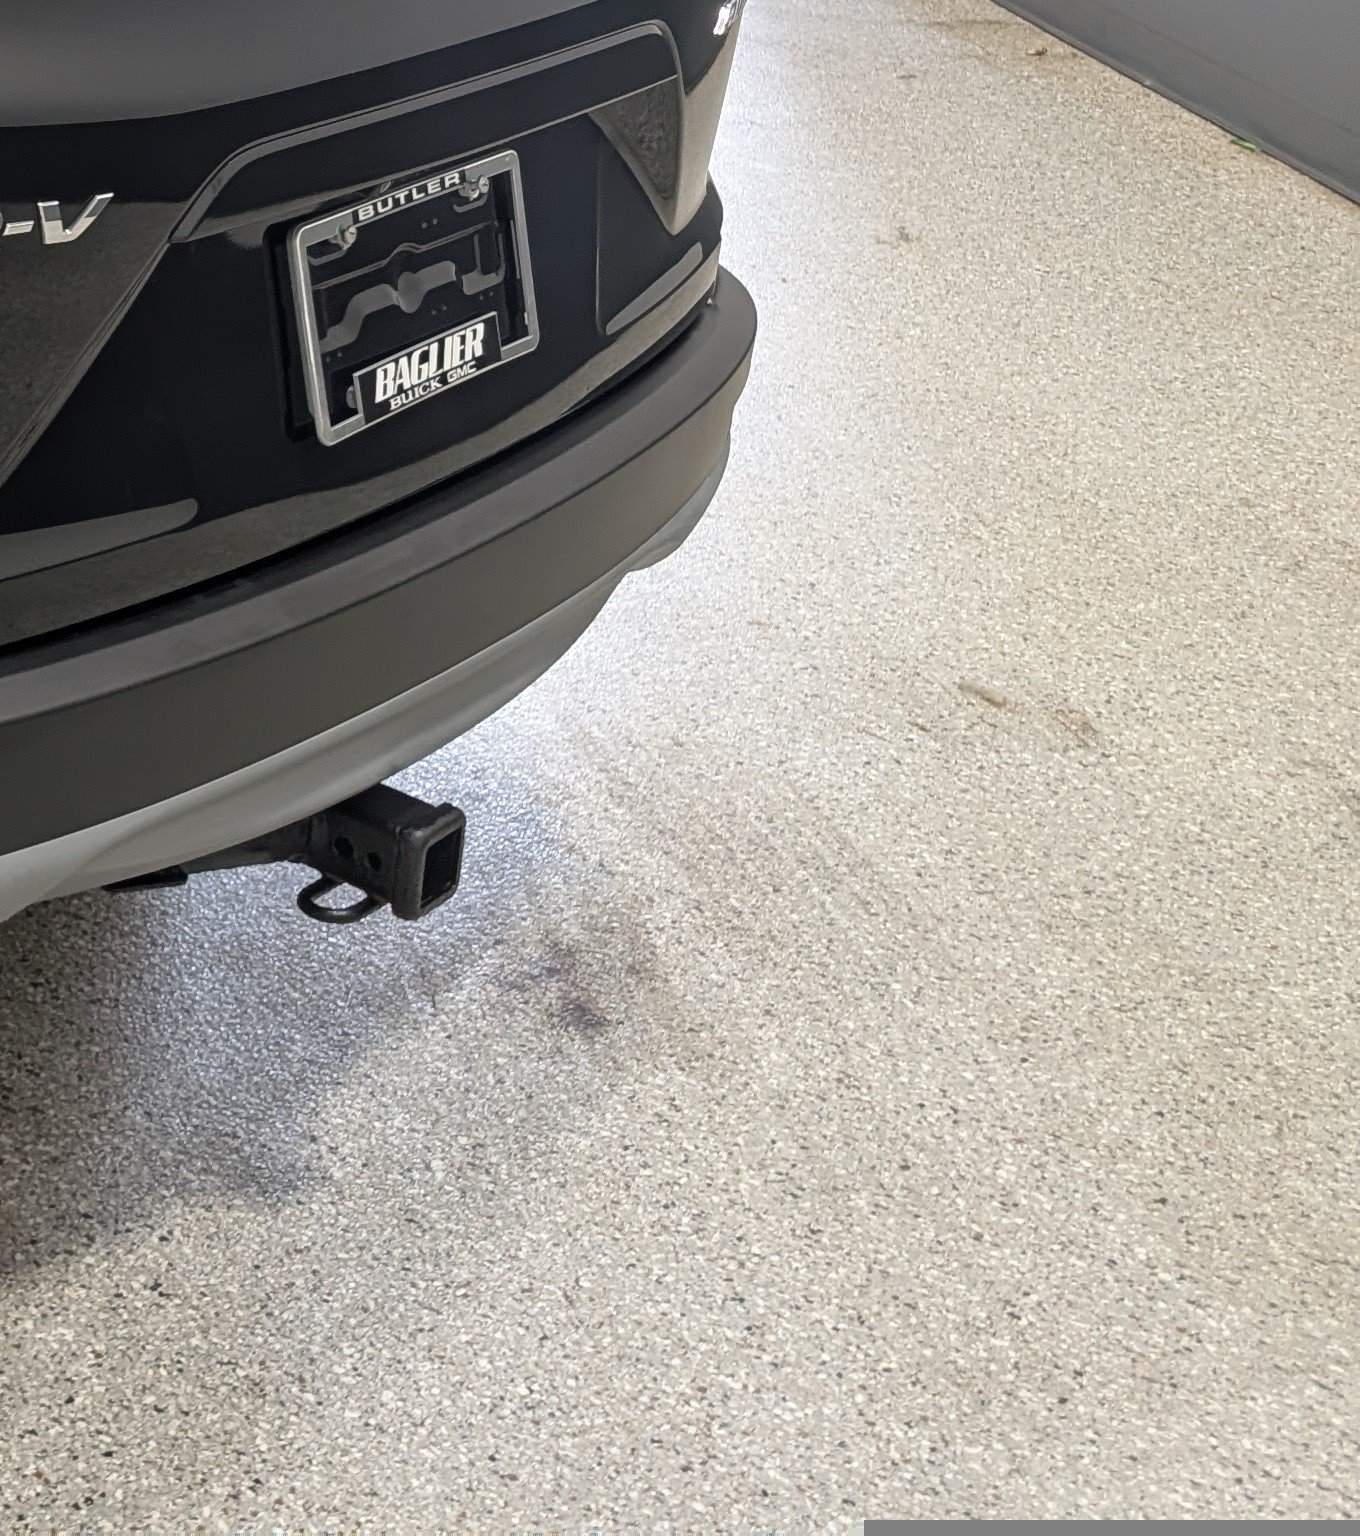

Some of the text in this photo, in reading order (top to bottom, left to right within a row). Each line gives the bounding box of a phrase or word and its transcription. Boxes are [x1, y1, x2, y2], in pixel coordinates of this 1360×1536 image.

[358, 172, 461, 221] BUTLER
[374, 321, 485, 404] BAGLIER
[389, 360, 477, 410] BUICK GMC
